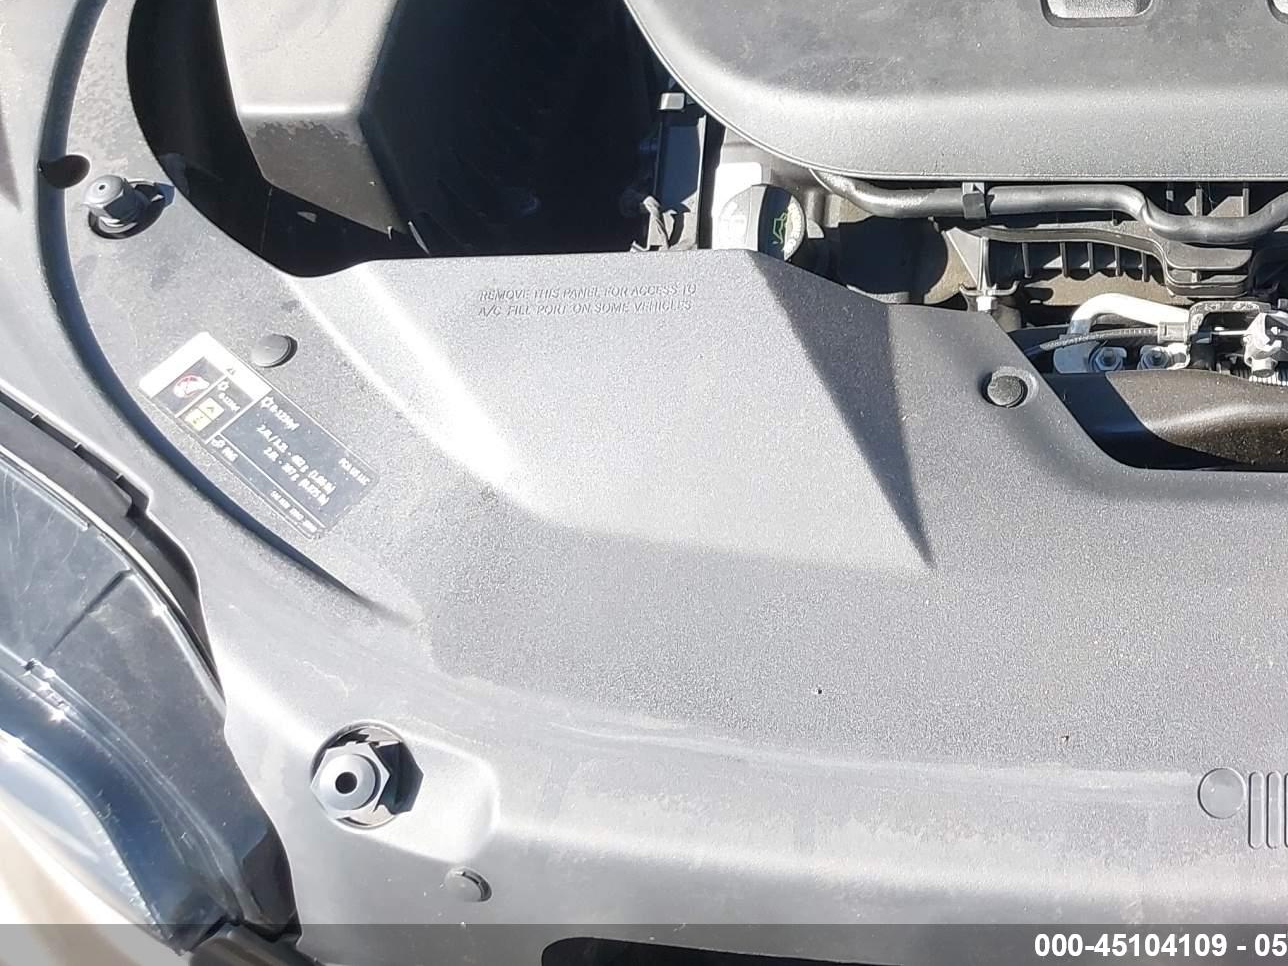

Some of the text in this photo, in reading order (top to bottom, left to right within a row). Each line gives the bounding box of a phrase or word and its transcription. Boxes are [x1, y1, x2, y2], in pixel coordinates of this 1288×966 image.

[480, 283, 697, 301] REMOVE THIS PANEL FOR ACCESS TO
[479, 299, 692, 317] A/C FILL PORT ON SOME VEHICLES
